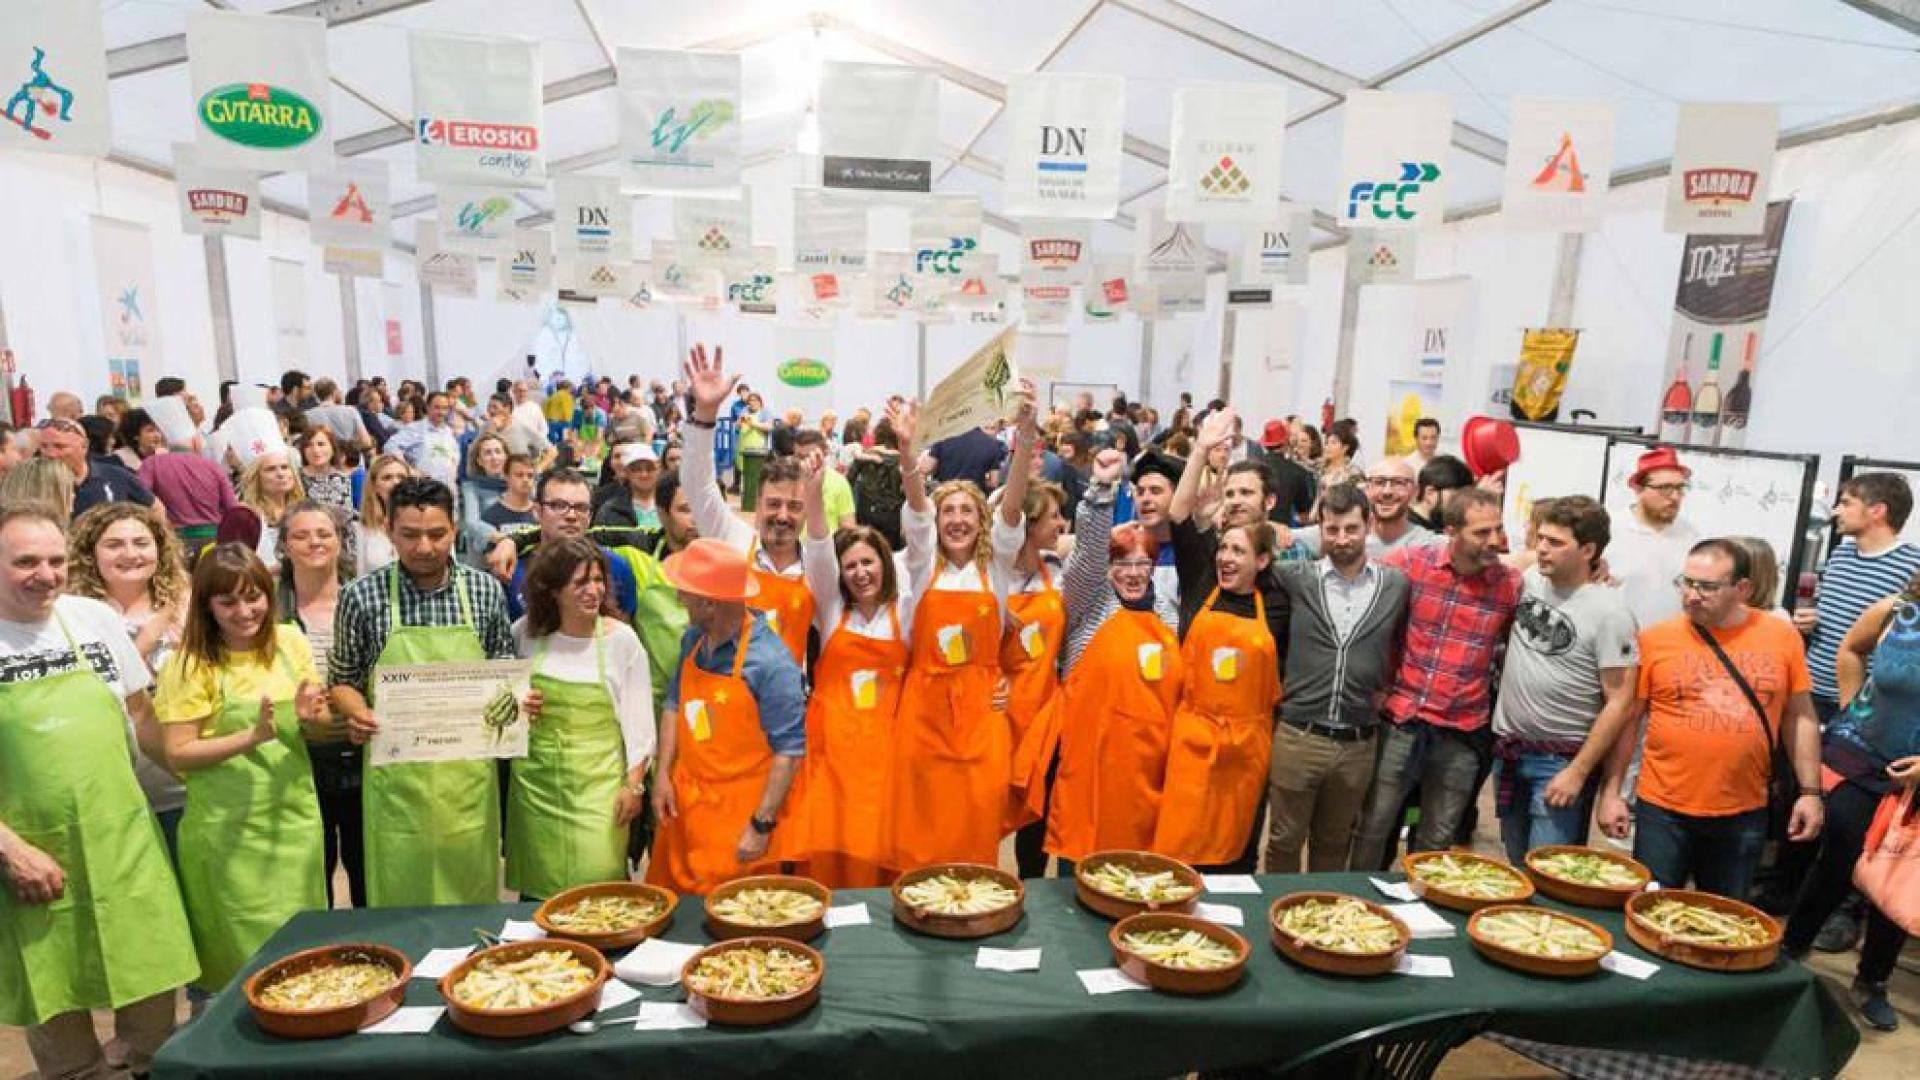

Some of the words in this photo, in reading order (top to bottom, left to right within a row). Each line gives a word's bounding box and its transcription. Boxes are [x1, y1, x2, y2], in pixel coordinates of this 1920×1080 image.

[453, 124, 533, 147] EROSKI
[1039, 125, 1087, 156] DN
[1348, 183, 1420, 219] FCC
[578, 206, 609, 226] DN
[1263, 232, 1290, 249] DN
[916, 250, 964, 274] FCC
[729, 284, 765, 302] FCC
[14, 666, 41, 682] LOS
[382, 672, 411, 684] XXIV
